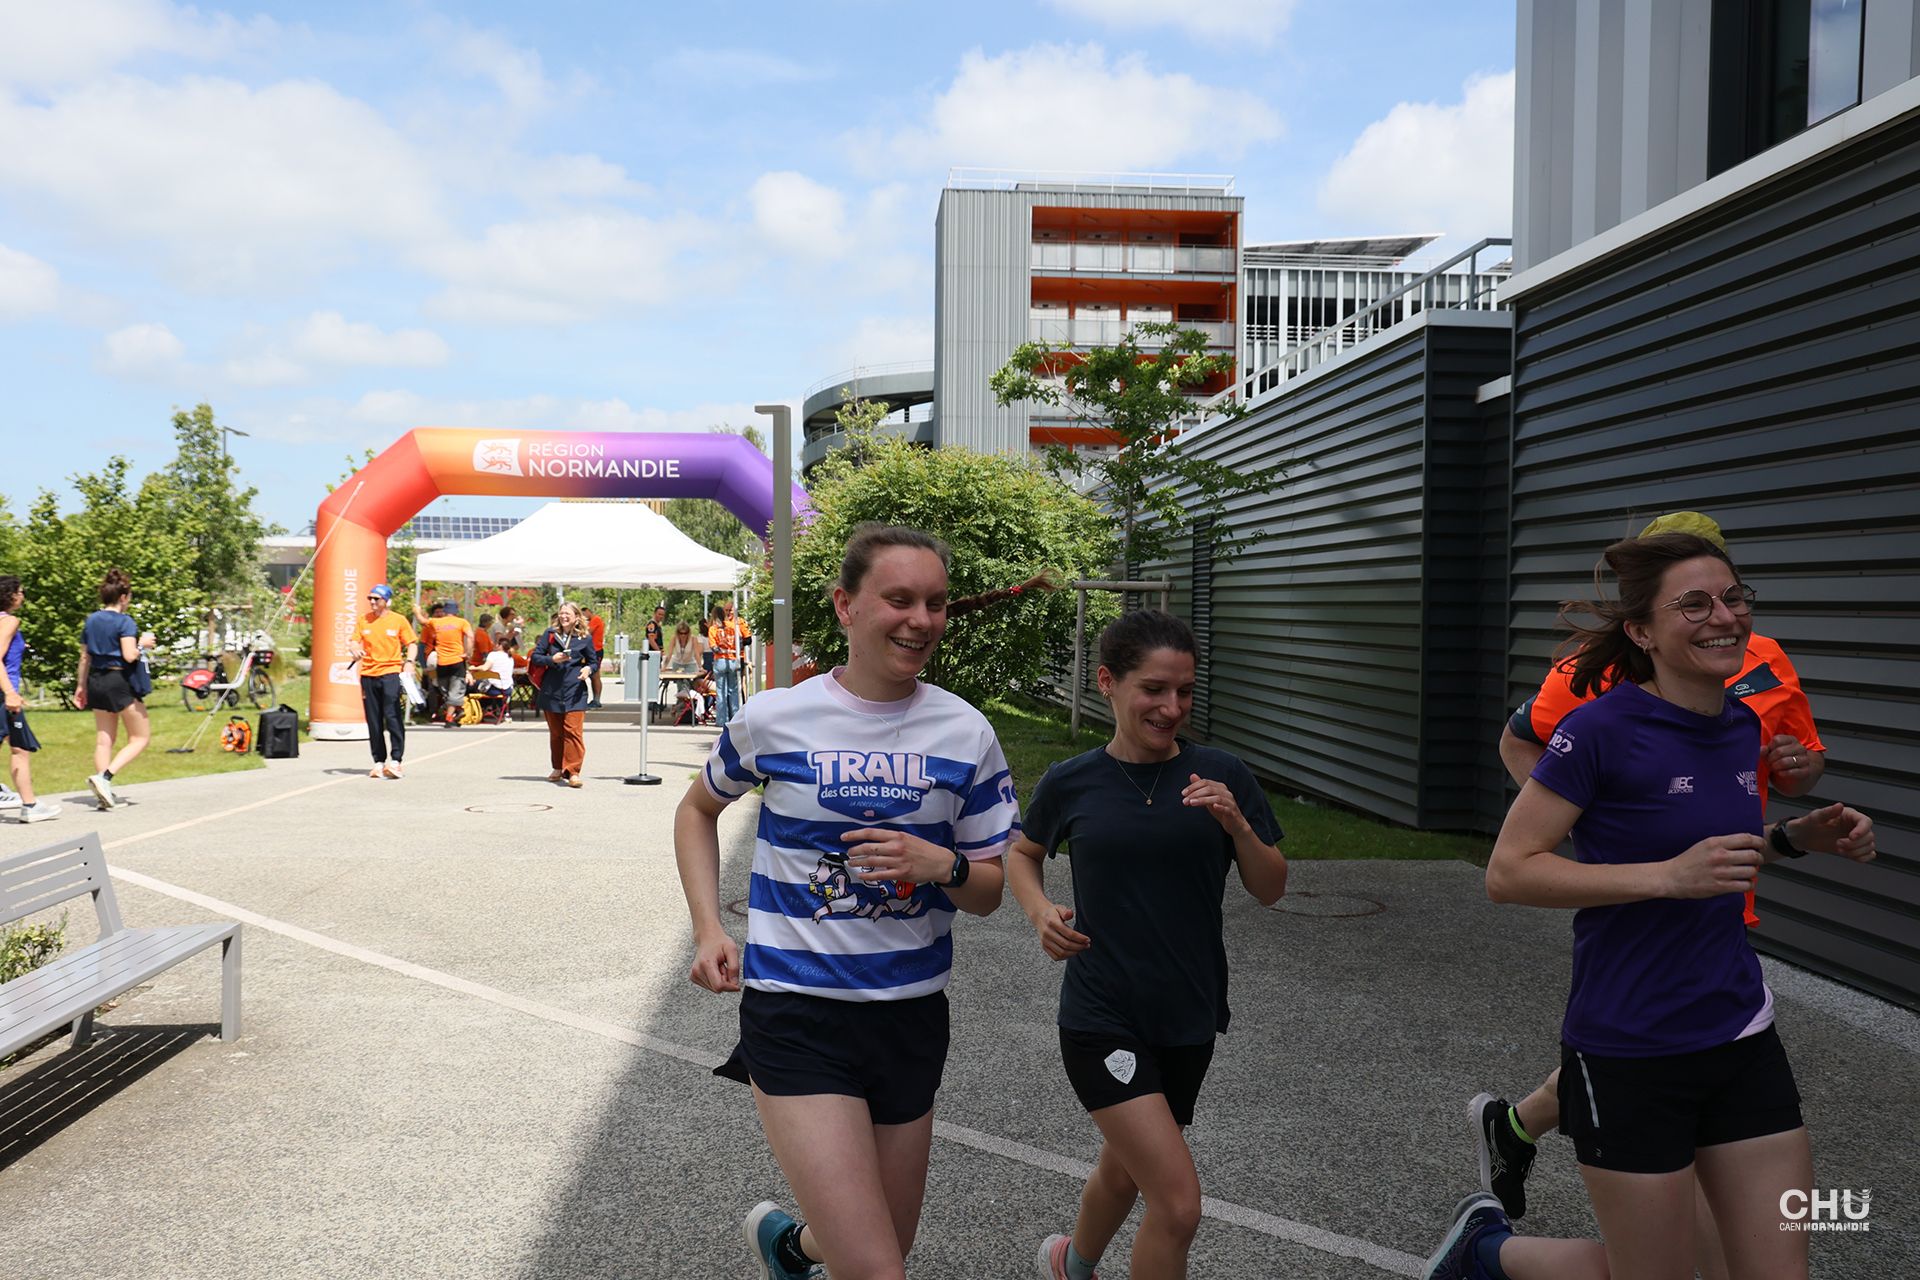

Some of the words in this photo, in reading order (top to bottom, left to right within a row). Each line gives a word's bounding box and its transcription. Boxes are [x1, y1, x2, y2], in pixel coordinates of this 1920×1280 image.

[529, 441, 604, 457] RÉGION
[528, 459, 680, 478] NORMANDIE
[814, 752, 931, 791] TRAIL
[821, 787, 839, 799] des
[839, 786, 878, 798] GENS
[881, 786, 921, 802] BONS
